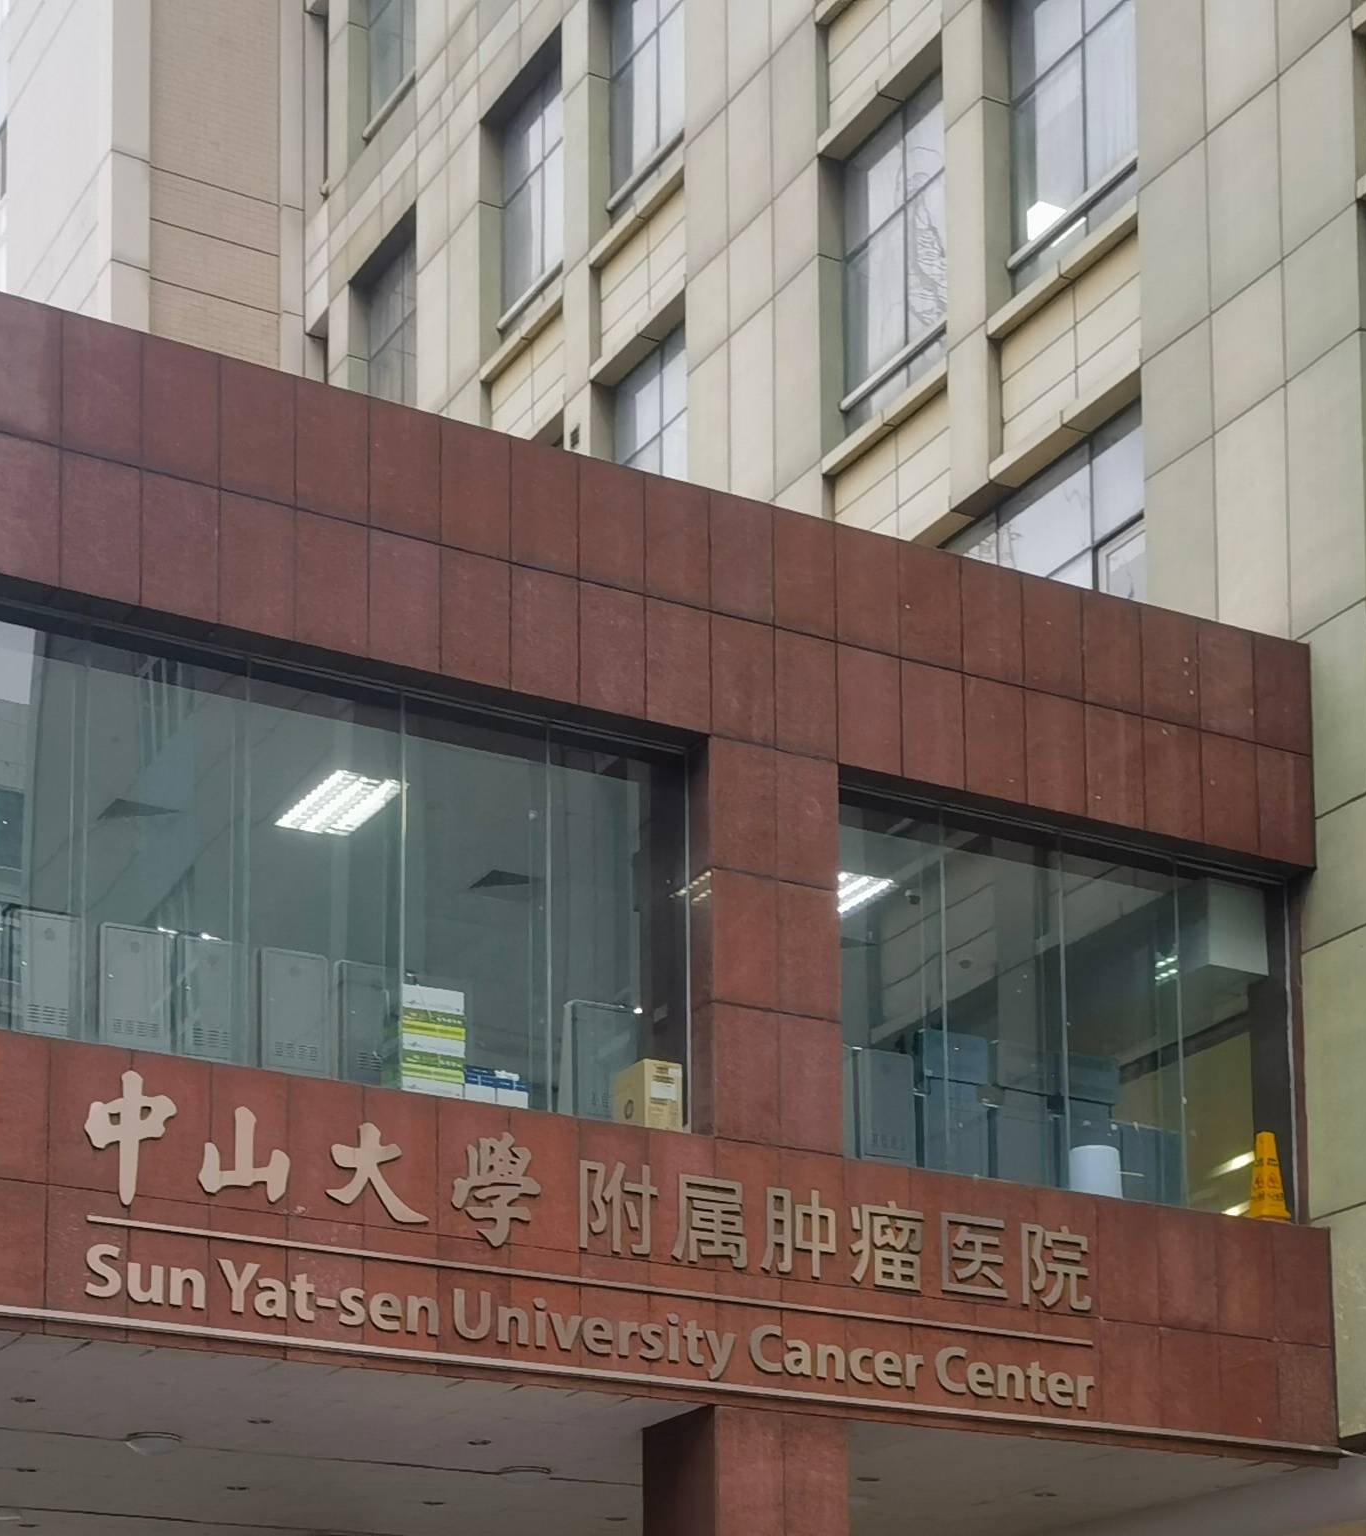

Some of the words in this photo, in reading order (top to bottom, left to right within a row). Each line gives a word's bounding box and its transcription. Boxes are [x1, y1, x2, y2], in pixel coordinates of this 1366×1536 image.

[83, 1070, 1092, 1312] 中山大學附属肿瘤医院
[85, 1243, 206, 1309] Sun
[218, 1258, 437, 1335] Yat-sen
[453, 1287, 735, 1382] University
[748, 1325, 924, 1390] Cancer
[935, 1345, 1095, 1411] Center
